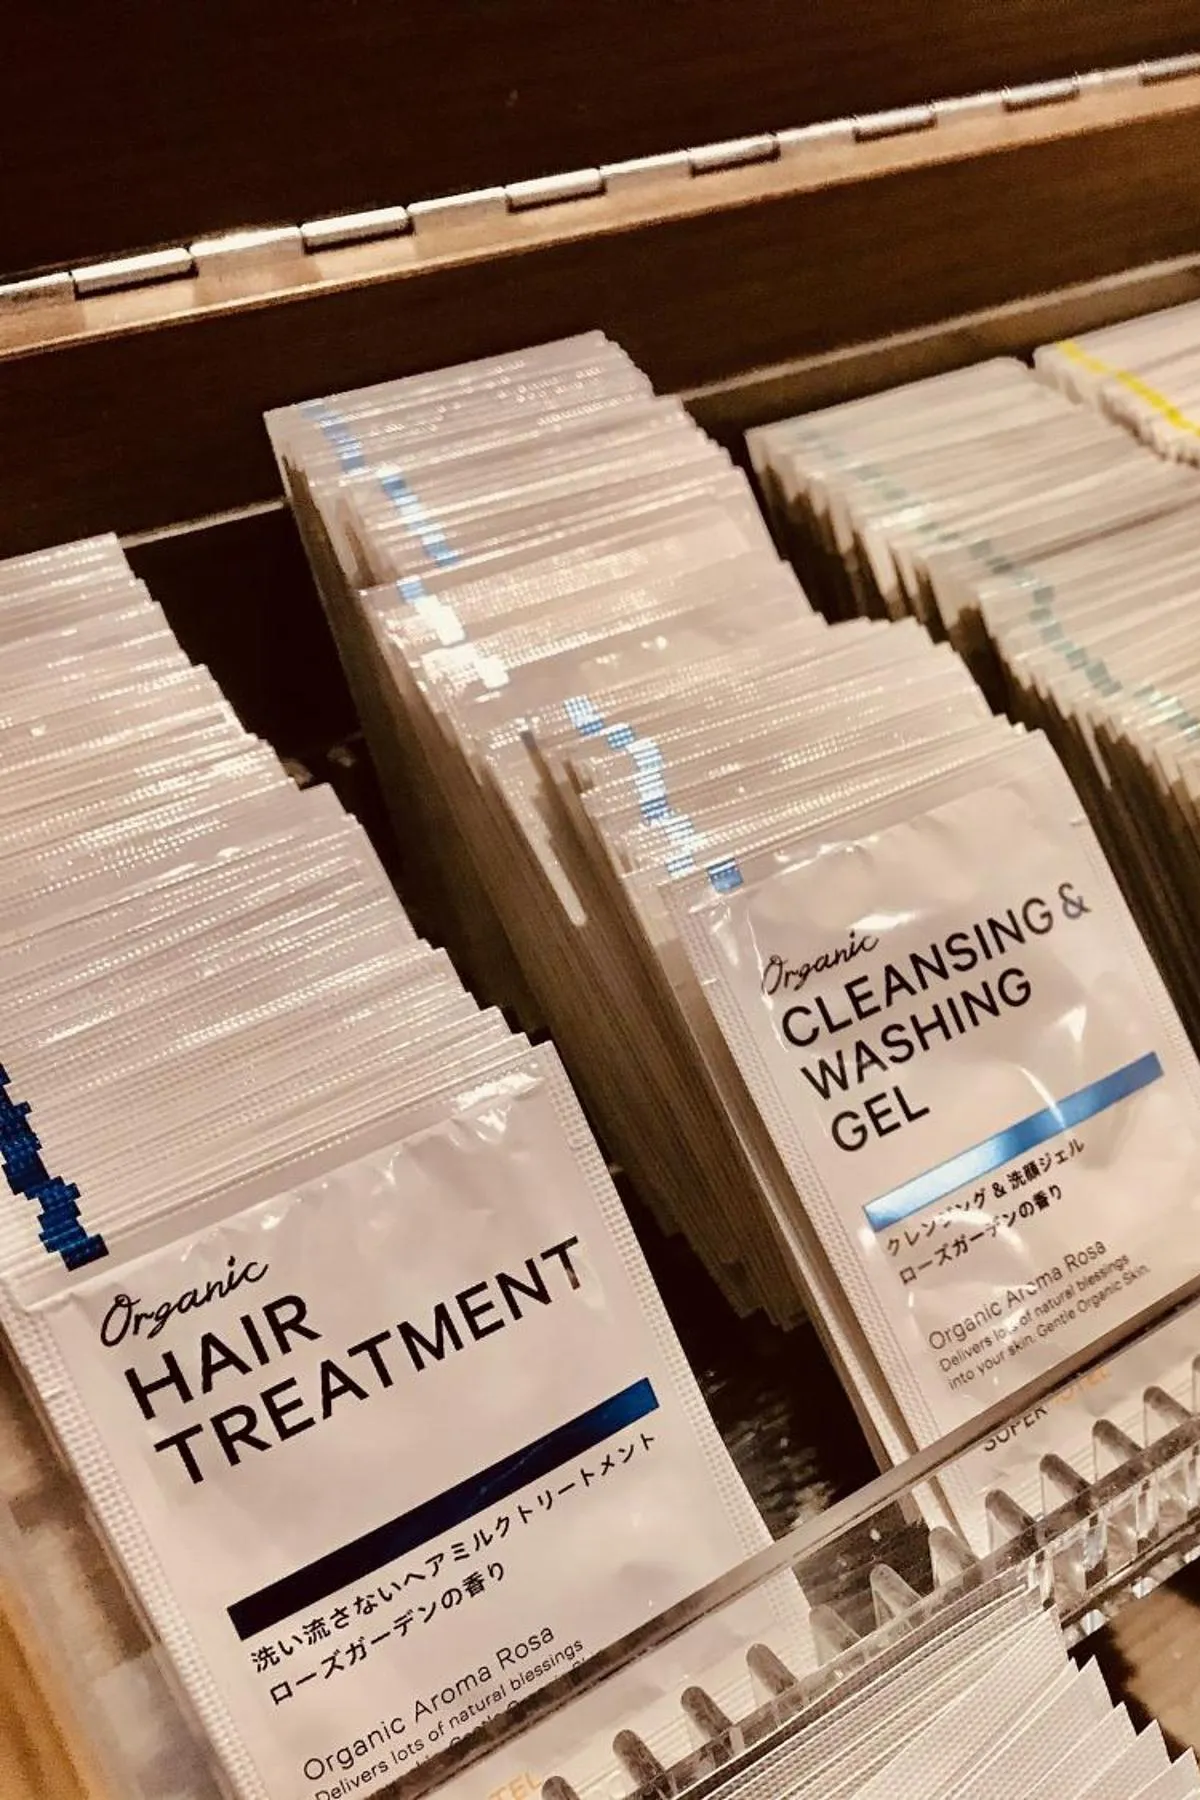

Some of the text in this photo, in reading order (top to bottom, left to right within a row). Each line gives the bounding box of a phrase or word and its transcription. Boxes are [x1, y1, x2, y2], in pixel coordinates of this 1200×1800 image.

[761, 929, 880, 997] Organic
[781, 883, 1092, 1048] CLEANSING &
[802, 968, 1033, 1101] WASHING
[831, 1085, 930, 1153] GEL
[900, 1184, 1062, 1285] ローズガーデンの香り
[929, 1240, 1107, 1351] Organic Aroma Rosa
[101, 1255, 269, 1347] Organic
[125, 1295, 322, 1420] HAIR
[155, 1236, 582, 1485] TREATMENT
[939, 1335, 993, 1373] Delivers
[1019, 1309, 1034, 1329] of
[1034, 1283, 1075, 1318] natural
[1076, 1254, 1130, 1292] blessings
[949, 1369, 975, 1391] into
[978, 1350, 1006, 1376] your
[1036, 1309, 1077, 1338] Gentle
[1078, 1280, 1123, 1313] Organic
[251, 1432, 656, 1672] 洗い流さないヘアミルクトリートメント
[270, 1561, 506, 1706] ローズガーデンの香り
[303, 1717, 406, 1780] Organic
[414, 1666, 492, 1723] Aroma
[496, 1626, 555, 1670] Rosa
[315, 1760, 388, 1800] Delivers
[391, 1738, 425, 1763] lots
[428, 1720, 444, 1742] of
[449, 1686, 507, 1729] natural
[509, 1638, 583, 1691] blessings
